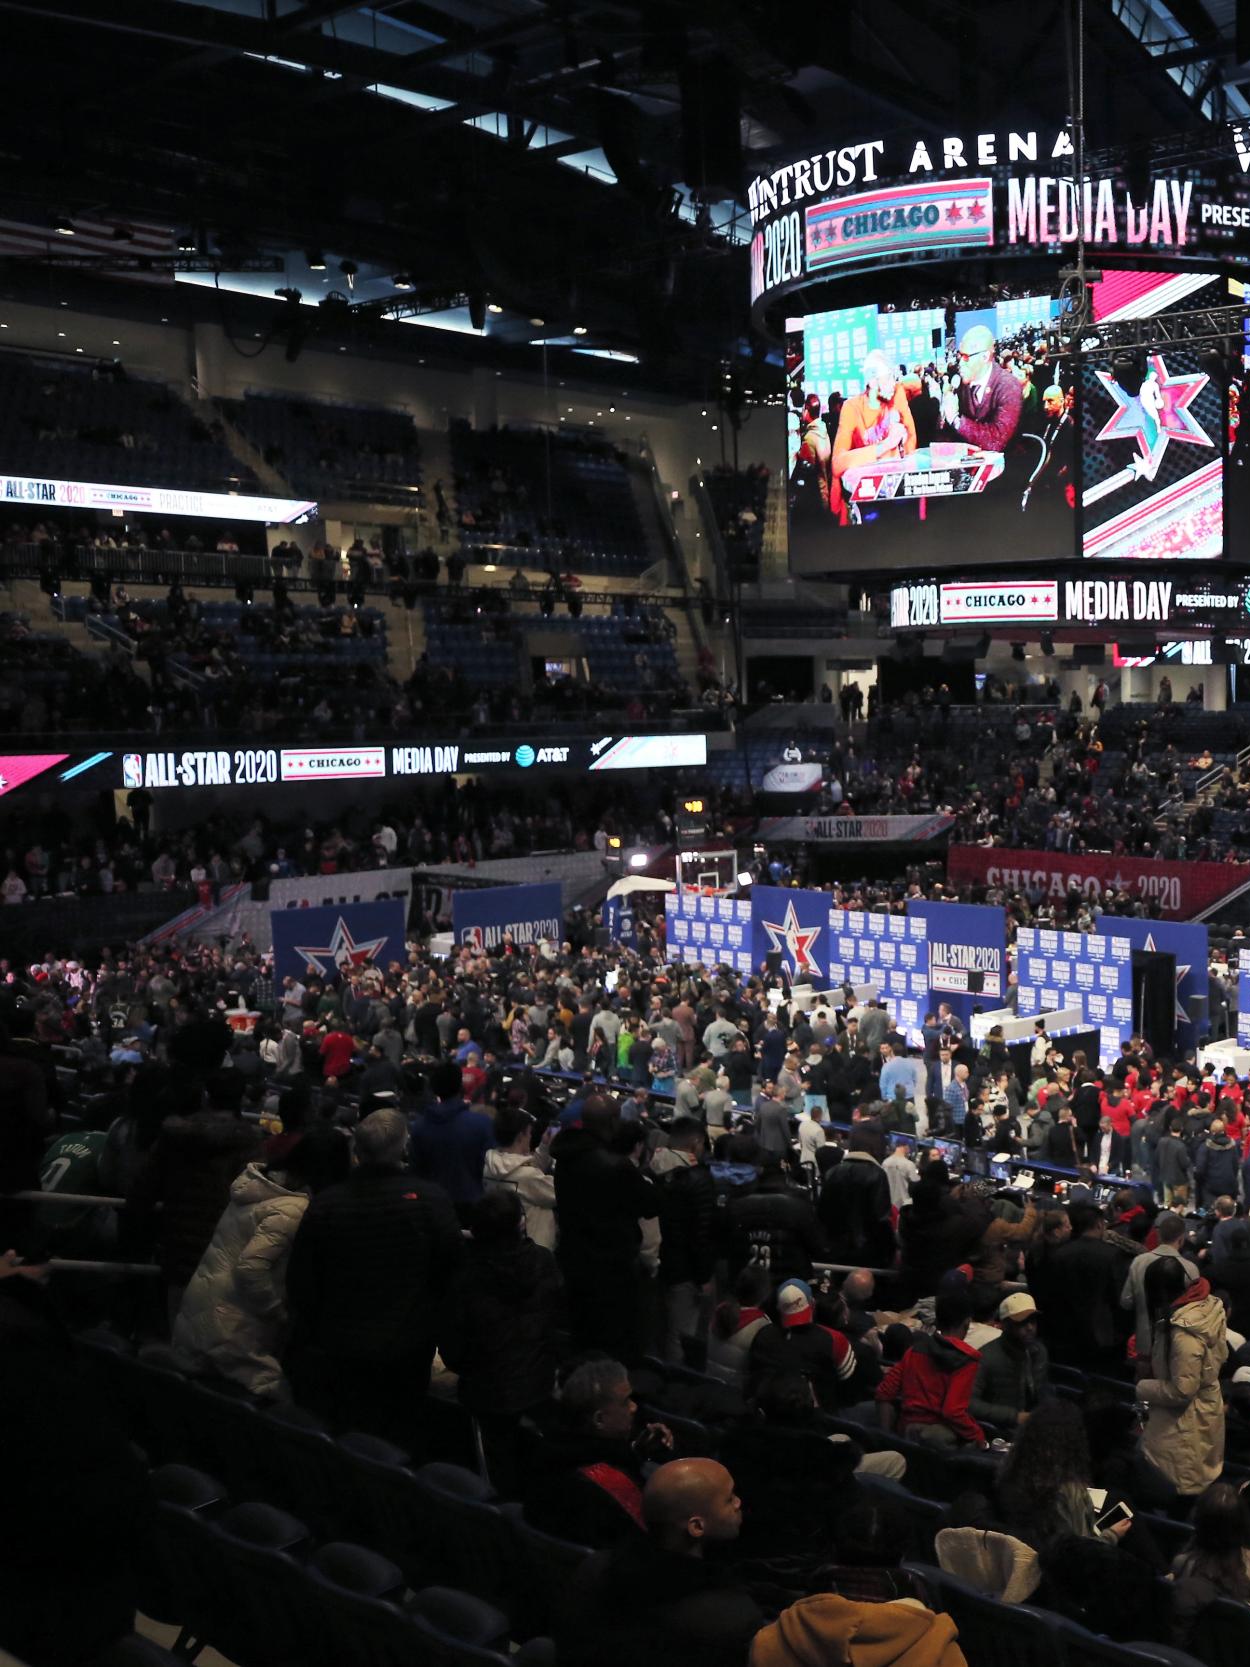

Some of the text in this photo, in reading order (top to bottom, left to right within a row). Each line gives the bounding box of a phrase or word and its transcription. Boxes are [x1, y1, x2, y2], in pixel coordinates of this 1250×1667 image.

[909, 131, 1074, 173] ARENA
[765, 211, 801, 290] 2020
[841, 205, 939, 240] CHICAGO
[1008, 176, 1118, 244] MEDIA
[1127, 178, 1192, 245] DAY
[59, 485, 86, 504] 2020
[909, 585, 938, 625] 2020
[965, 594, 1026, 607] CHICAGO
[1065, 581, 1129, 620] MEDIA
[1133, 581, 1172, 620] DAY
[1176, 594, 1225, 608] PRESENTED
[1226, 596, 1239, 609] BY
[235, 750, 277, 783] 2020
[308, 758, 361, 768] CHICAGO
[393, 747, 432, 775] MEDIA
[434, 746, 459, 772] DAY
[464, 752, 500, 764] PRESENTED
[536, 747, 569, 763] AT&T
[863, 820, 888, 837] 2020
[1137, 875, 1181, 911] 2020
[976, 947, 1001, 971] 2020
